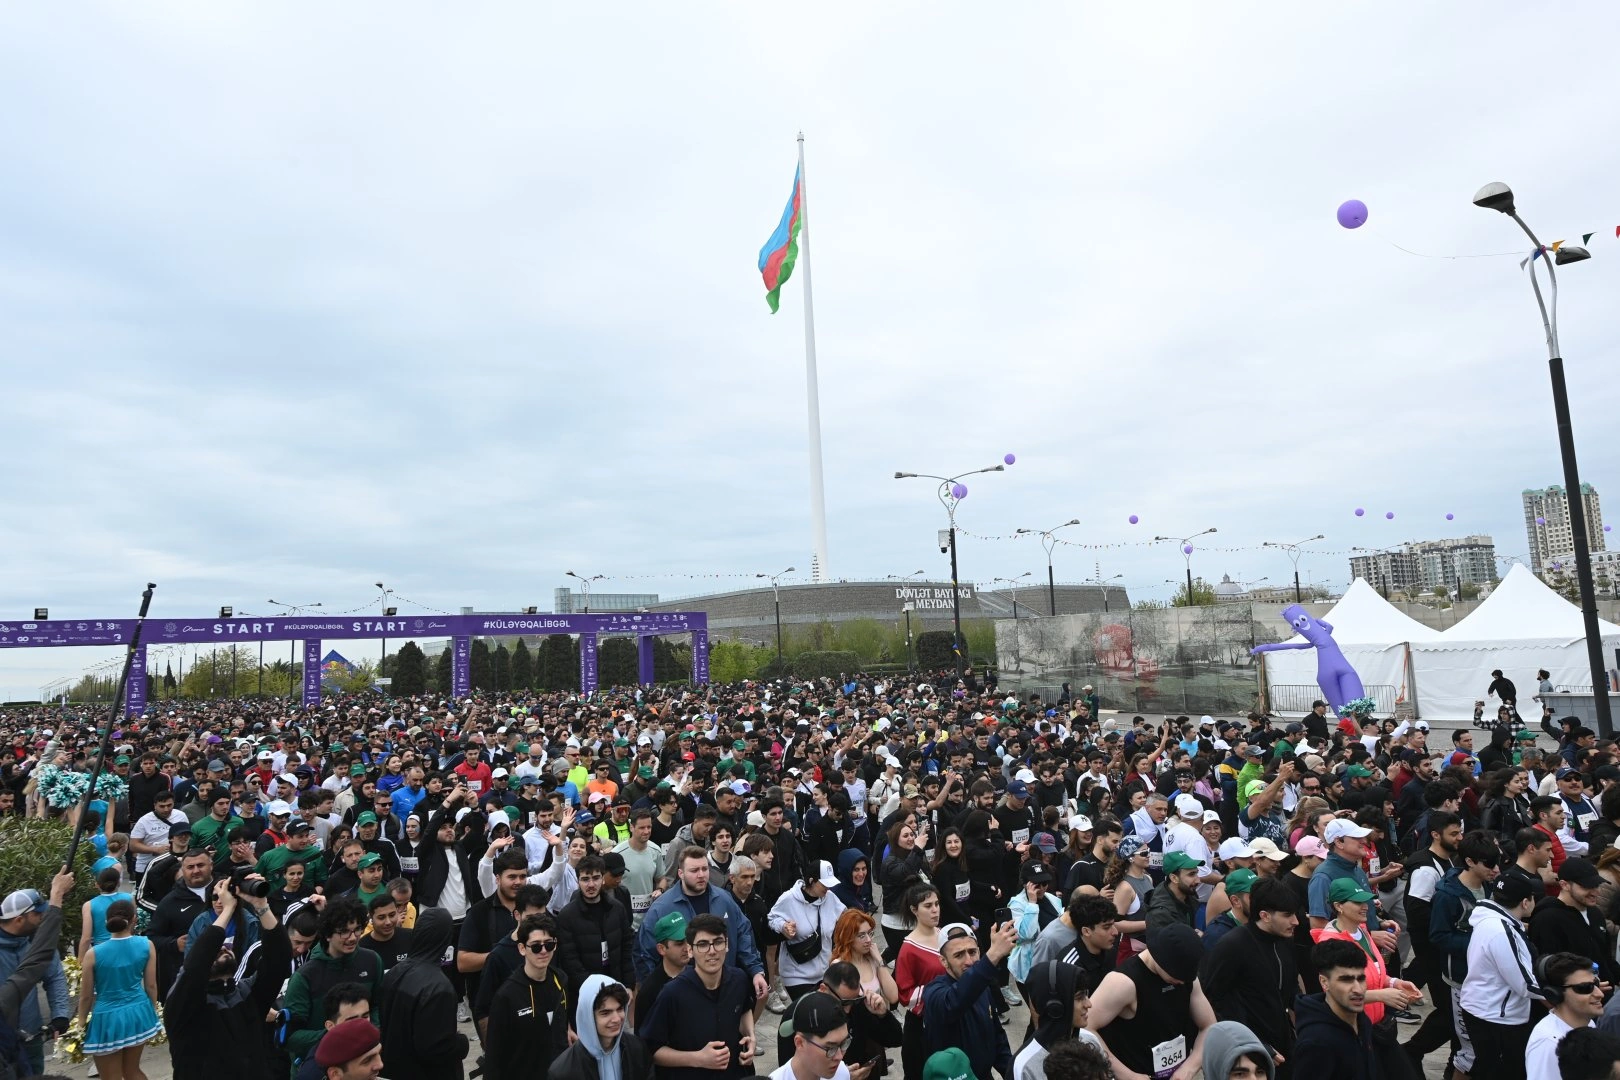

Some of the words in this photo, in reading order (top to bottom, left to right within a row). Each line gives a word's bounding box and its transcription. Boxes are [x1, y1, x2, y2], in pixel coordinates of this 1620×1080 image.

[213, 623, 275, 634] START
[353, 622, 406, 632] START
[483, 618, 571, 629] #KÜLƏYƏQALİBGƏL
[1161, 1050, 1183, 1067] 3654
